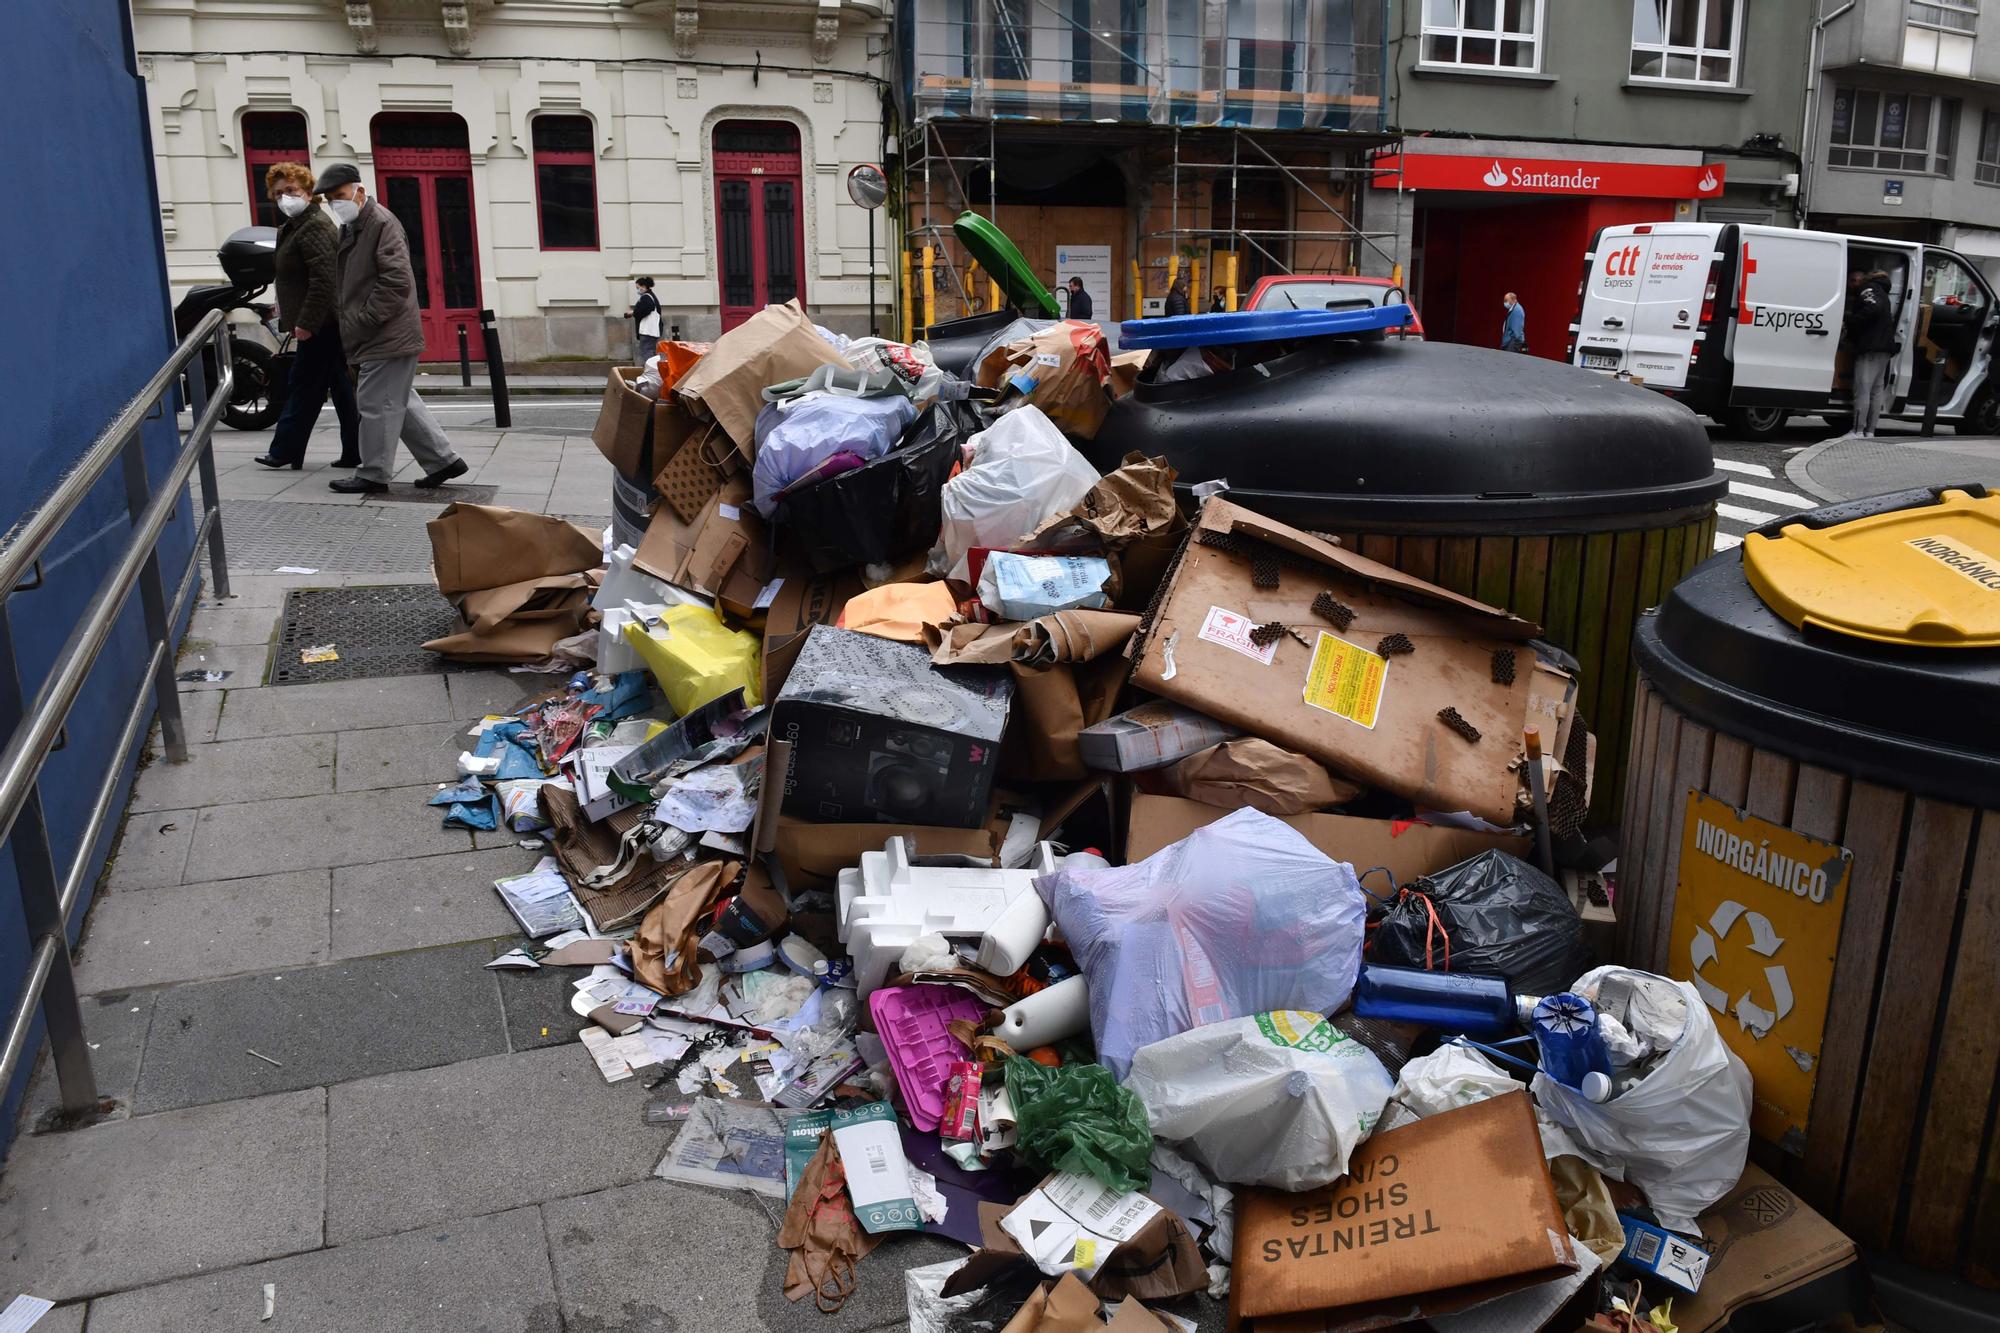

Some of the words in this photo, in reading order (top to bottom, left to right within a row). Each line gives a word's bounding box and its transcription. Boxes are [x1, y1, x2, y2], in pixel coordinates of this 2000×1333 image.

[1511, 167, 1600, 189] Santander
[1605, 245, 1640, 276] ctt
[1664, 252, 1674, 260] red
[1604, 278, 1633, 288] Express
[1754, 306, 1824, 332] Express
[1208, 627, 1268, 655] FRAGILE
[1696, 818, 1828, 904] INORGÁNICO
[1290, 1182, 1408, 1227] SHOES
[1262, 1209, 1440, 1262] TREINTAS
